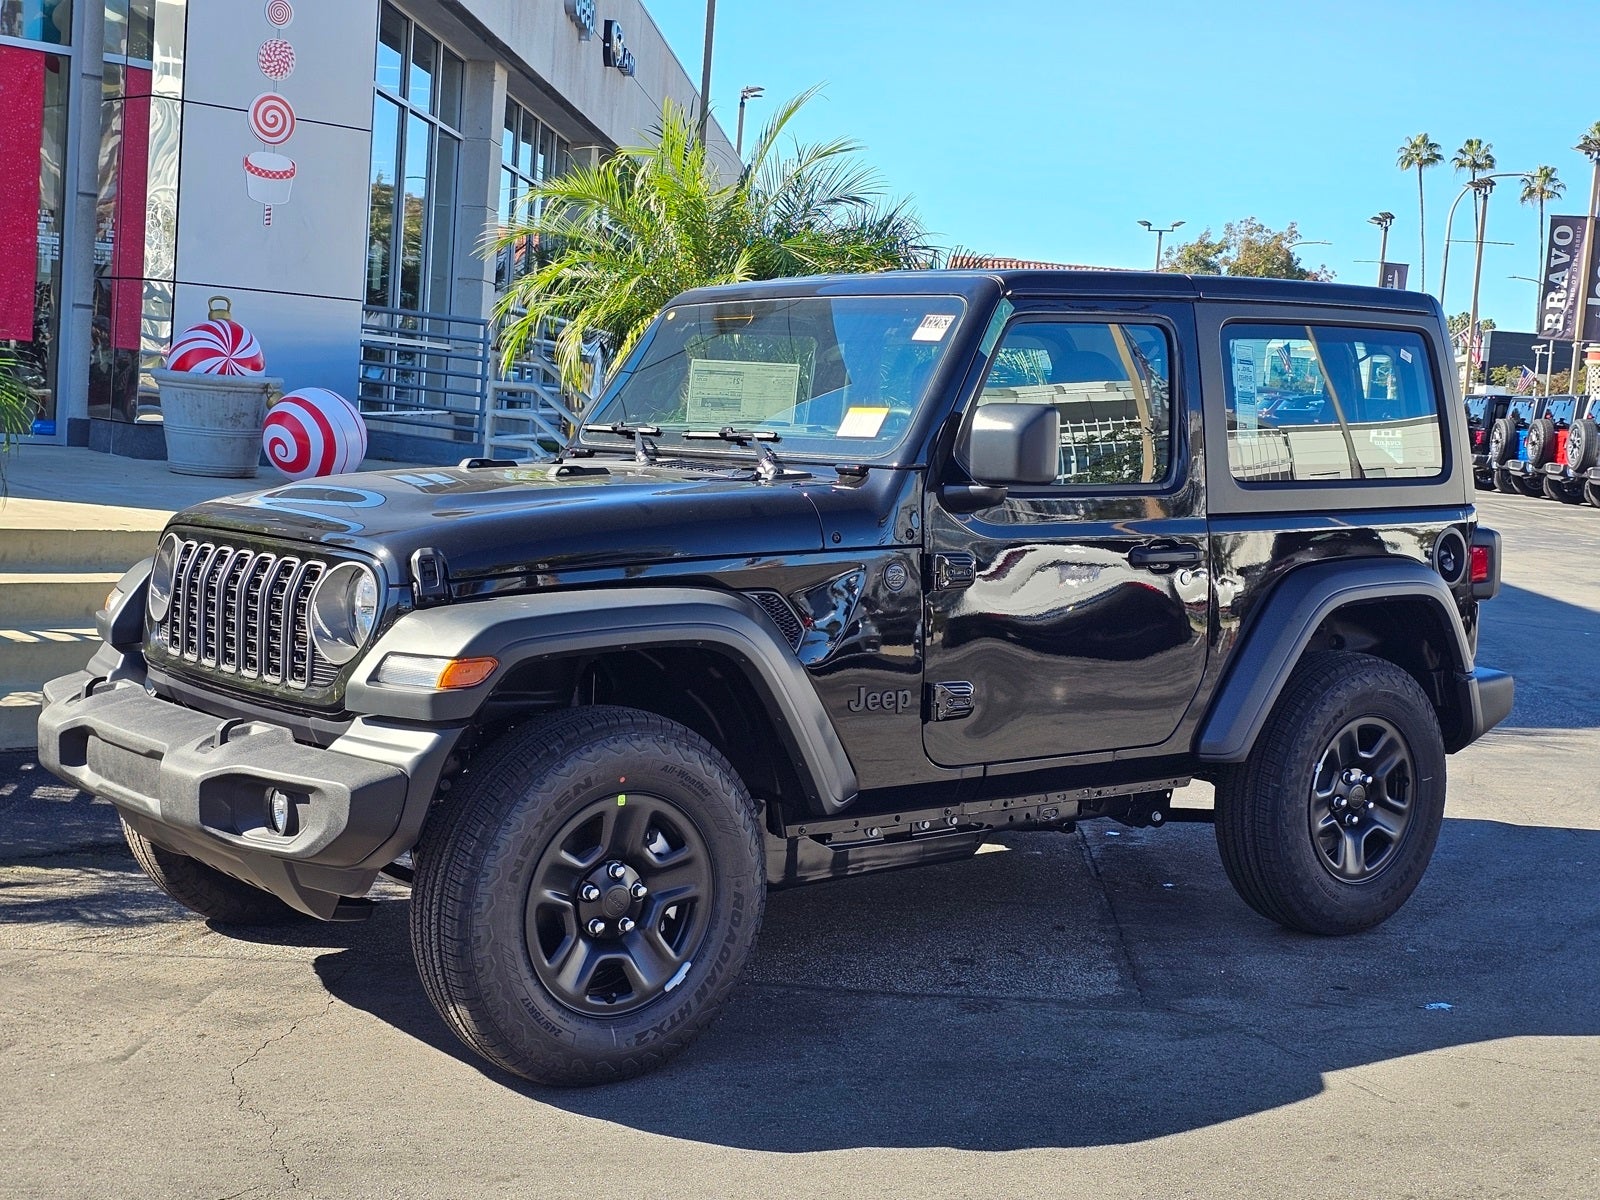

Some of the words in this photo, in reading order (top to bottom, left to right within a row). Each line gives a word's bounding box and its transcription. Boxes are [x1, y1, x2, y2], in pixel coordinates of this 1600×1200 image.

[1572, 225, 1582, 272] DEALERSHIP
[1544, 225, 1573, 331] BRAVO
[1568, 287, 1576, 306] KIND
[1571, 274, 1577, 285] OF
[1566, 310, 1574, 326] NEW
[848, 686, 911, 714] Jeep
[508, 776, 592, 883] NEXEN
[694, 891, 744, 999] ROADIAN
[521, 998, 563, 1037] 245/75R17
[634, 1000, 693, 1047] HTX2
